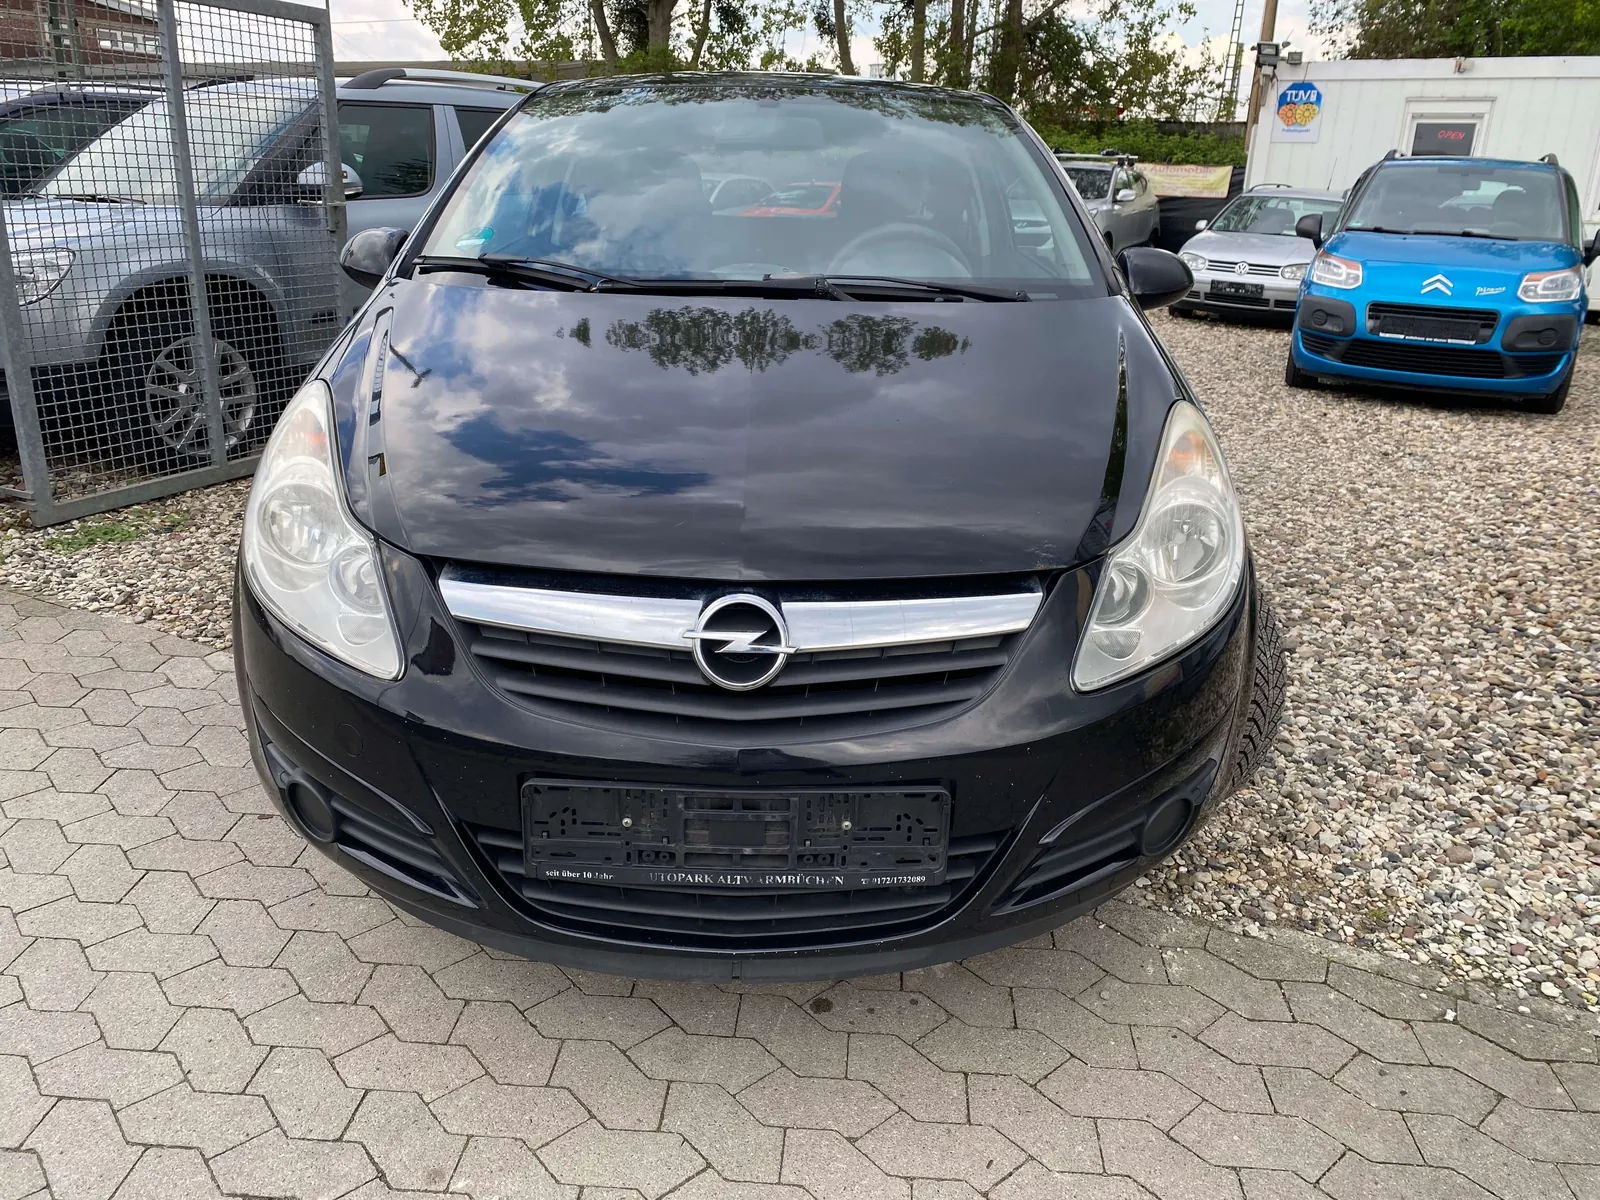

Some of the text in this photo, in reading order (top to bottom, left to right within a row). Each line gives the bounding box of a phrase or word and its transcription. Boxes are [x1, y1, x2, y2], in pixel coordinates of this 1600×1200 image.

[1285, 90, 1311, 101] TÜV
[1438, 130, 1466, 140] OPEN
[561, 870, 581, 878] über
[583, 871, 592, 879] 10
[594, 872, 615, 880] Jahr
[649, 872, 714, 884] UTOPARK
